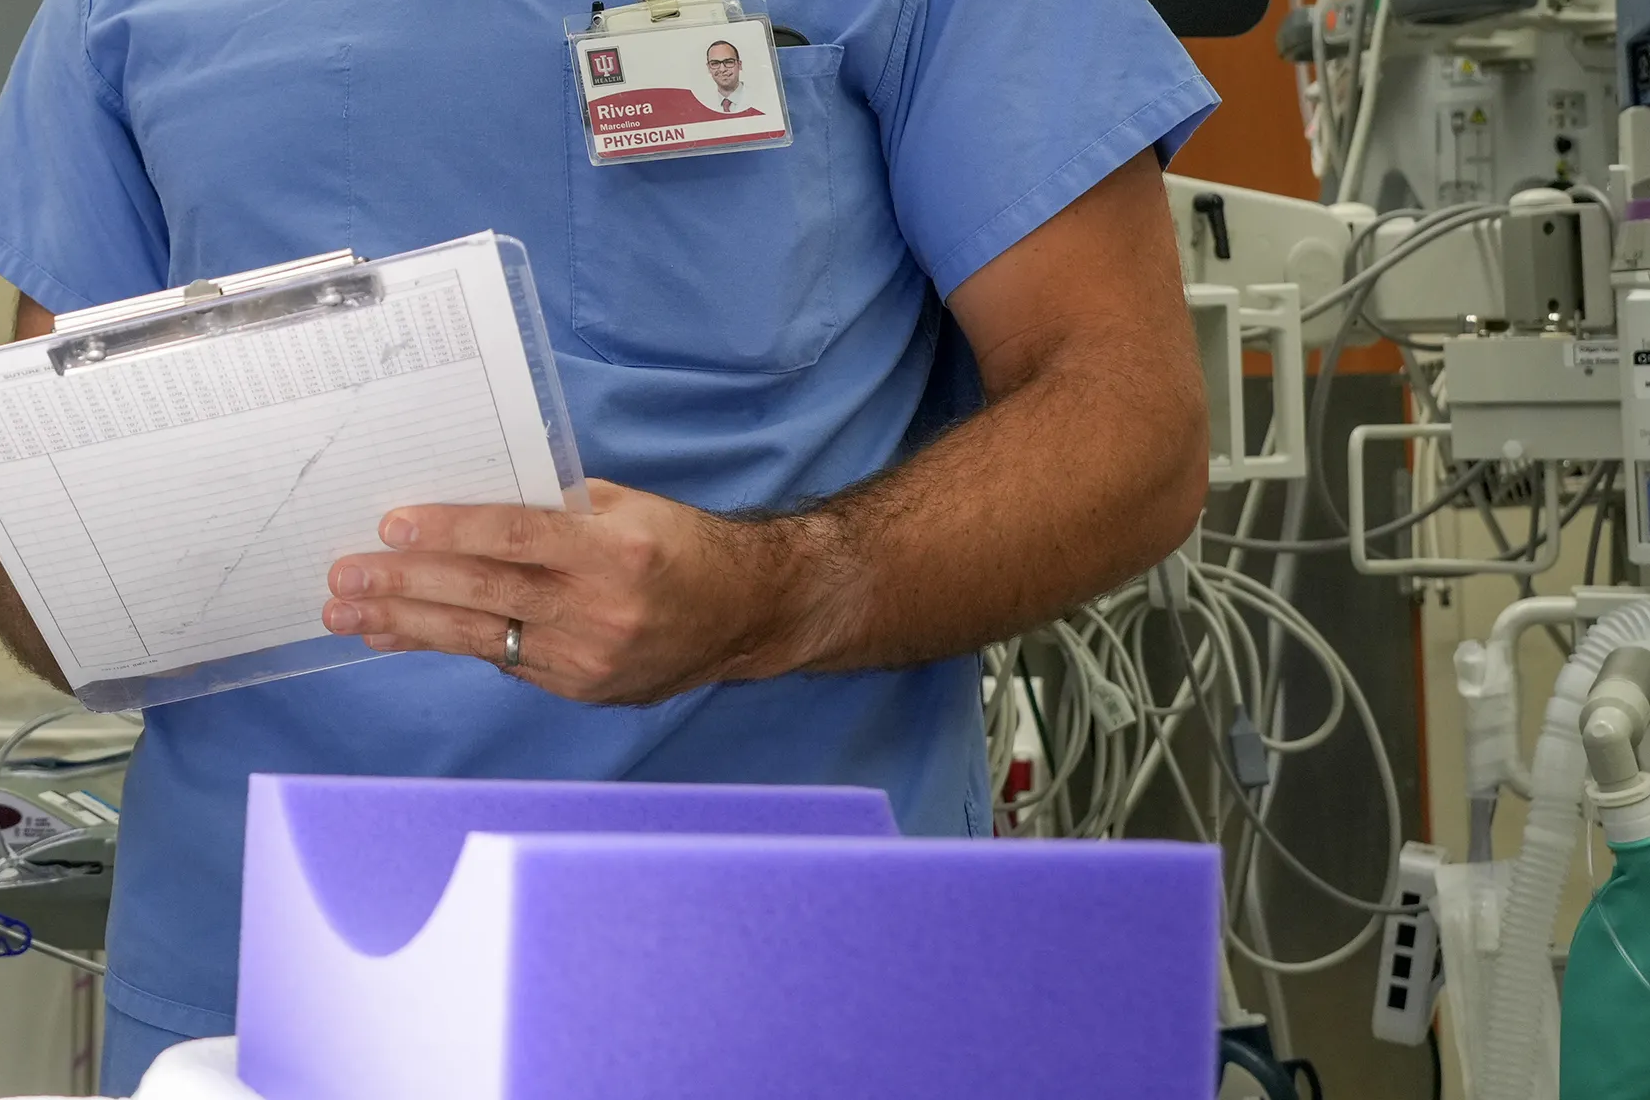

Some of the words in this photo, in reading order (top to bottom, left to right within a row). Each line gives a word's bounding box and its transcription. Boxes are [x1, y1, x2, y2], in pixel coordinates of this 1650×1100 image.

[594, 76, 622, 84] HEALTH
[596, 102, 653, 120] Rivera
[599, 119, 641, 132] Marcelino
[602, 127, 686, 149] PHYSICIAN
[3, 368, 40, 380] SUTURE
